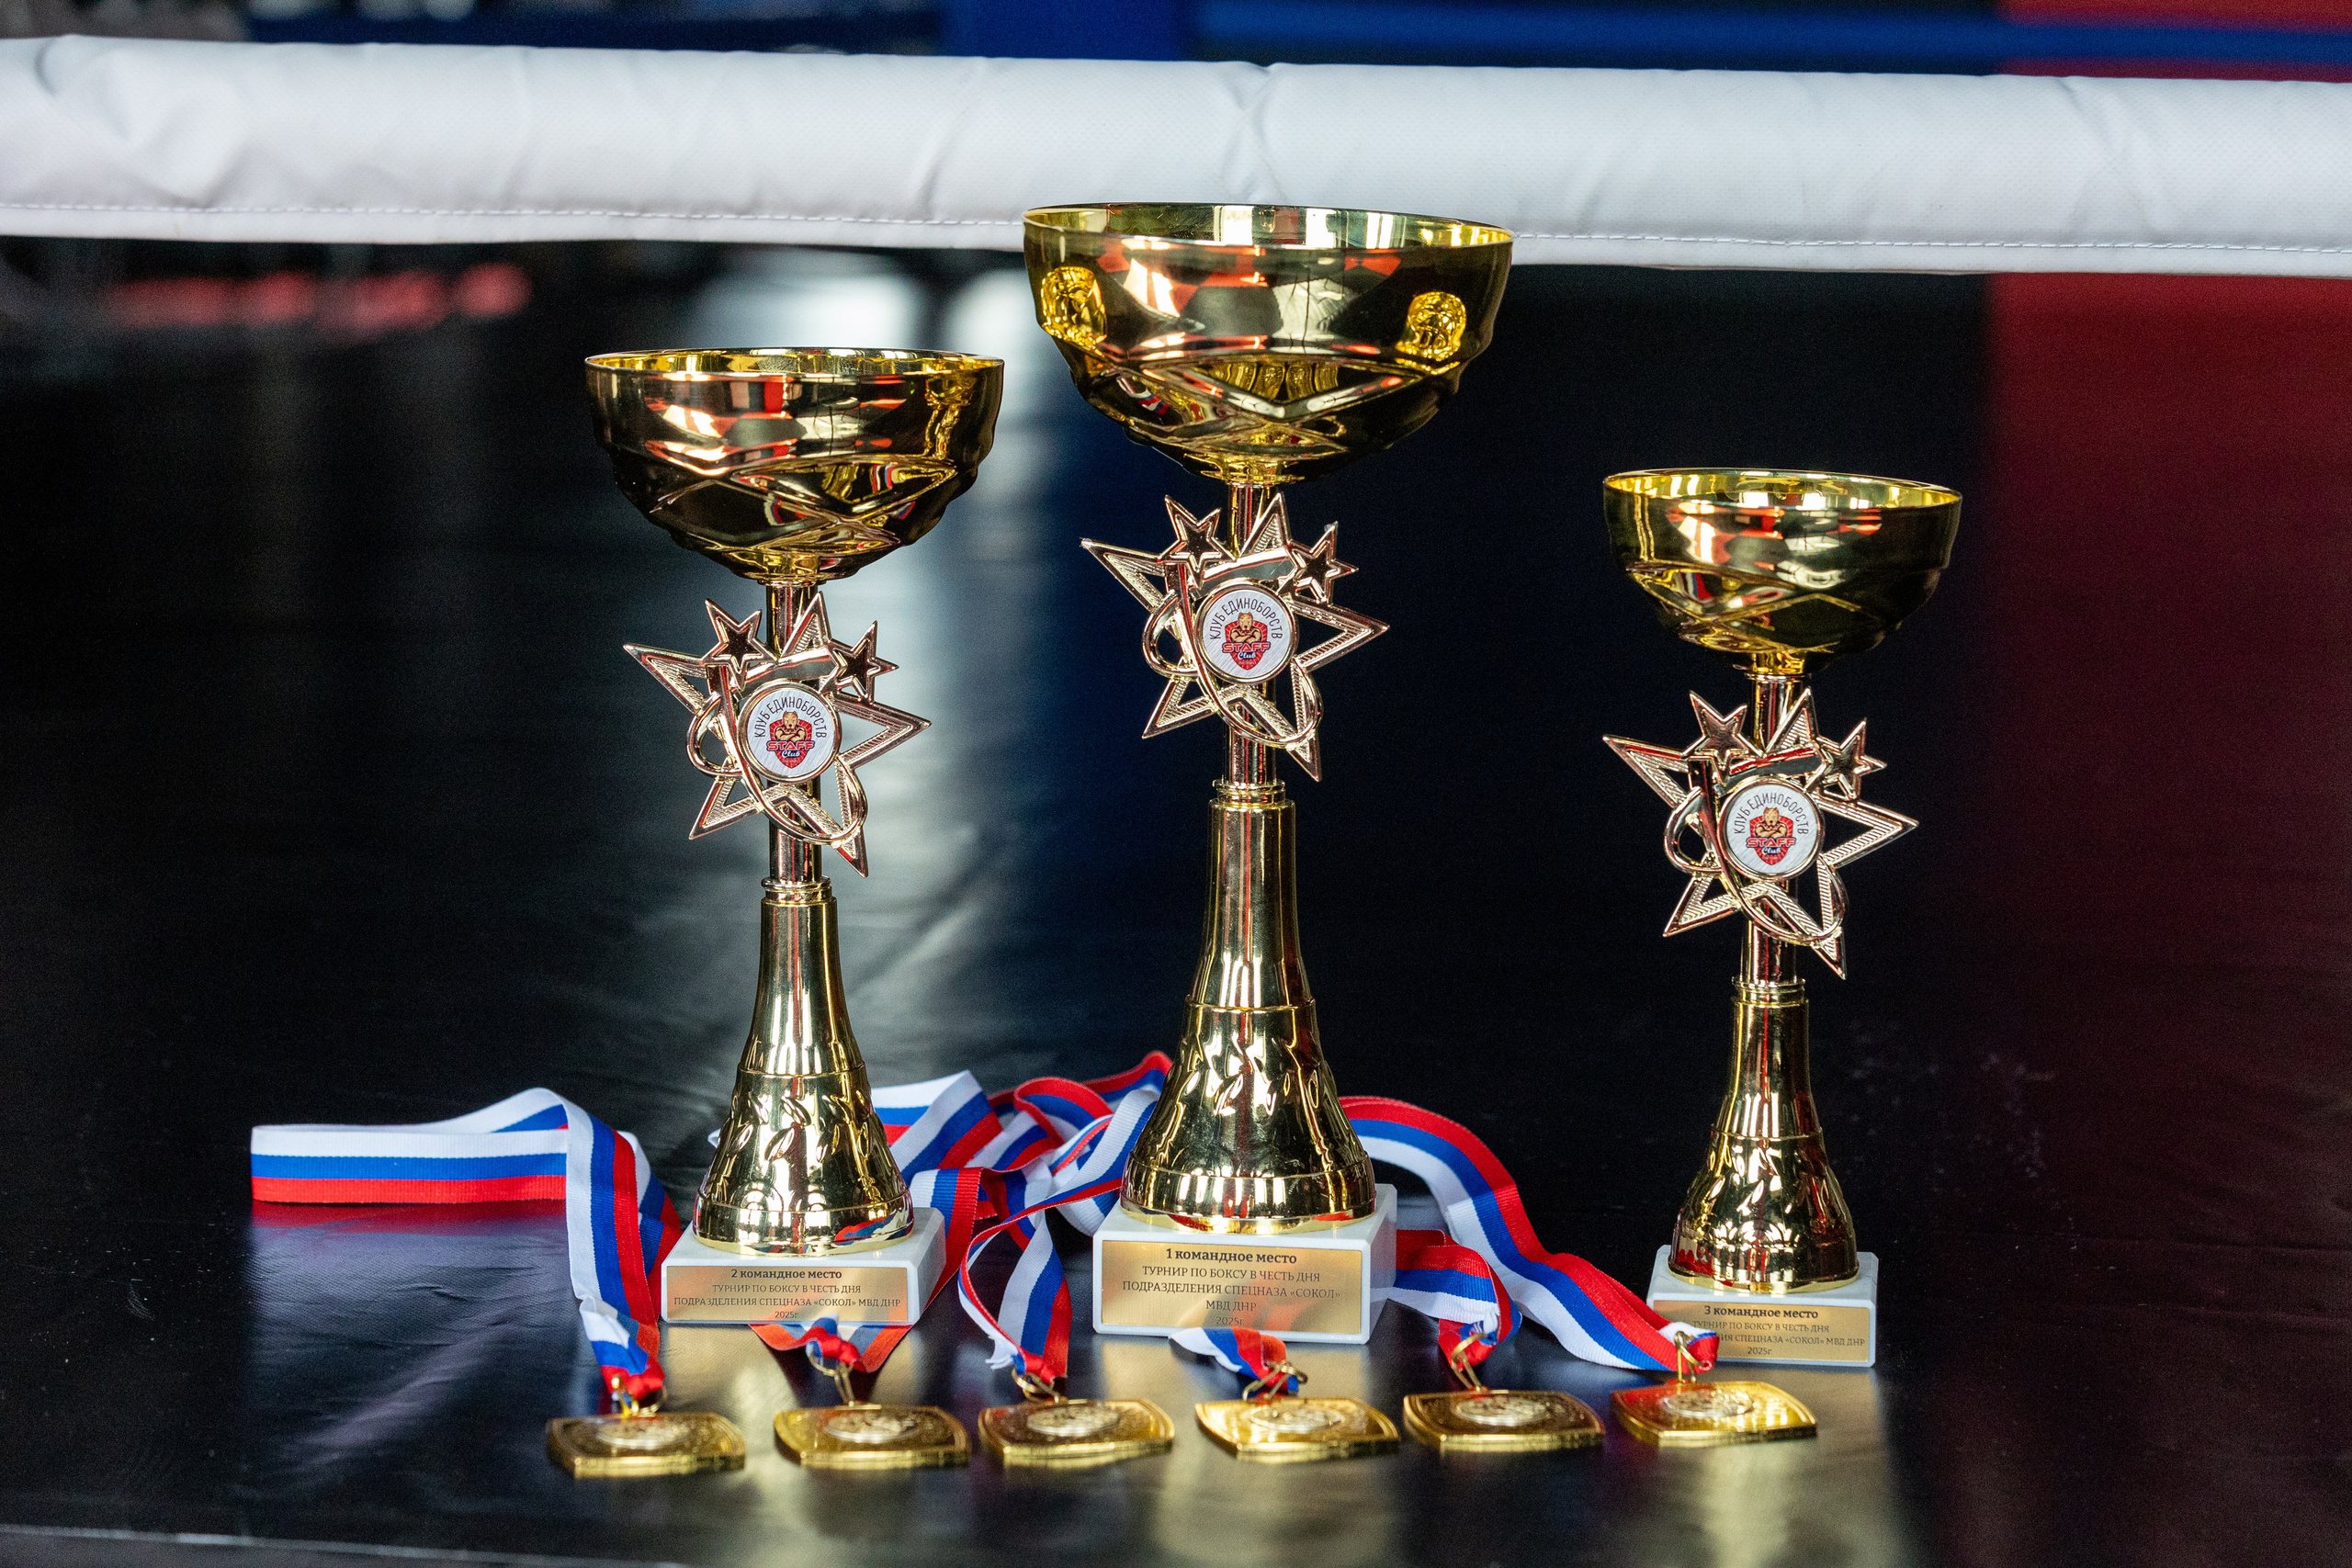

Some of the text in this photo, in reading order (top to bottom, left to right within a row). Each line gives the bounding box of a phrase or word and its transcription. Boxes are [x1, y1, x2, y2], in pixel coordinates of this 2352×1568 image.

[1210, 598, 1283, 639] КЛУБ ЕДИНОБОРСТВ
[1223, 643, 1270, 651] STAFF
[754, 696, 827, 738] КЛУБ ЕДИНОБОРСТВ
[767, 741, 814, 750] STAFF
[1734, 793, 1809, 834] КЛУБ ЕДИНОБОРСТВ
[1747, 838, 1795, 847] STAFF
[1166, 1248, 1297, 1264] 1 командное место
[731, 1269, 842, 1280] 2 командное место
[1142, 1266, 1320, 1282] ТУРНИР ПО БОКСУ В ЧЕСТЬ ДНЯ
[841, 1285, 861, 1294] ДНЯ
[1123, 1280, 1340, 1299] ПОДРАЗДЕЛЕНИЯ СПЕЦНАЗА «СОКОЛ»
[673, 1298, 757, 1307] ПОДРАЗДЕЛЕНИЯ
[759, 1298, 811, 1307] СПЕЦНАЗА
[858, 1299, 880, 1307] МВД
[881, 1299, 900, 1307] ДНР
[1205, 1301, 1257, 1312] МВД ДНР
[775, 1311, 798, 1319] 2025г
[1704, 1305, 1711, 1314] 3
[1713, 1307, 1781, 1319] командное
[1216, 1316, 1244, 1325] 2025г
[1745, 1323, 1773, 1331] БОКСУ
[1811, 1325, 1829, 1333] ДНЯ
[1736, 1335, 1783, 1344] СПЕЦНАЗА
[1785, 1337, 1824, 1345] «СОКОЛ»
[1826, 1337, 1846, 1346] МВД
[1847, 1338, 1865, 1347] ДНР
[1747, 1347, 1772, 1356] 2025г
